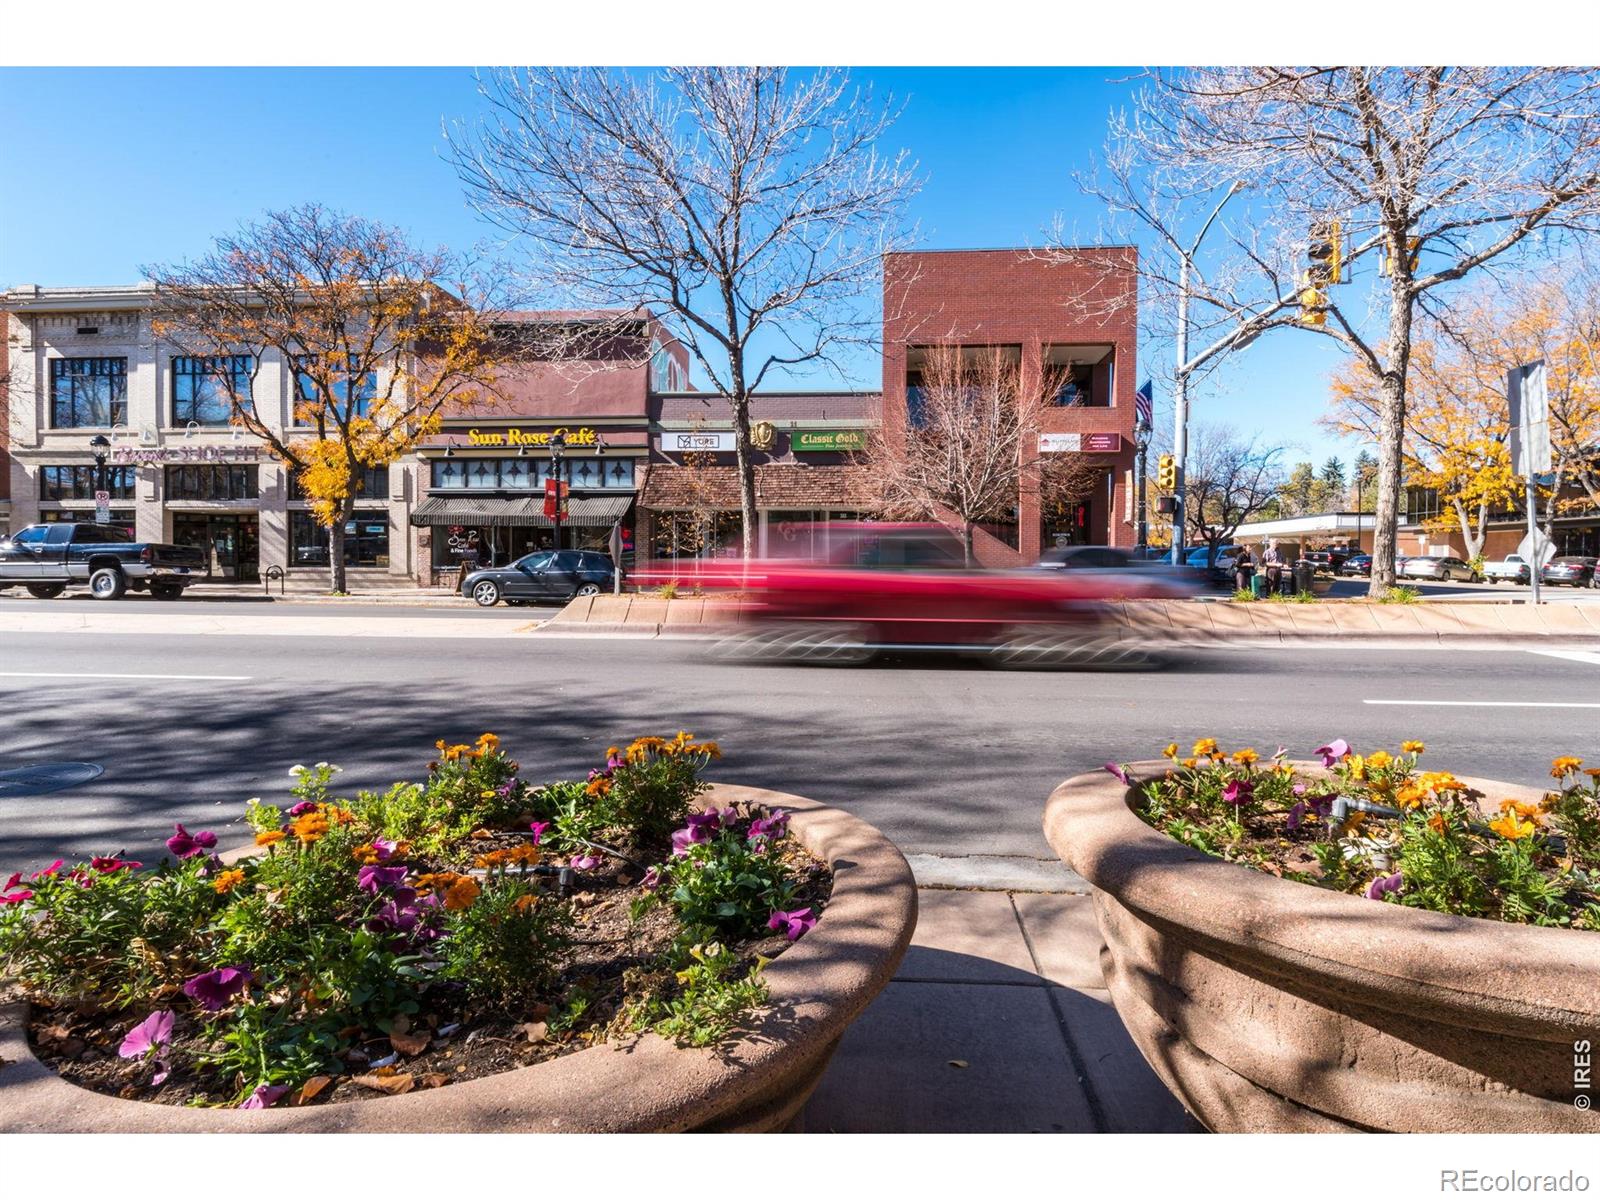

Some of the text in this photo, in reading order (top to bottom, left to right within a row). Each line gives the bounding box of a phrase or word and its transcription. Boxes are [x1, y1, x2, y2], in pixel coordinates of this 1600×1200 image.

[468, 428, 502, 445] Sun
[508, 428, 549, 445] Rose
[693, 438, 714, 446] YORE
[800, 433, 859, 444] Classic Gold
[178, 446, 226, 462] SHOE
[233, 446, 262, 462] FIT
